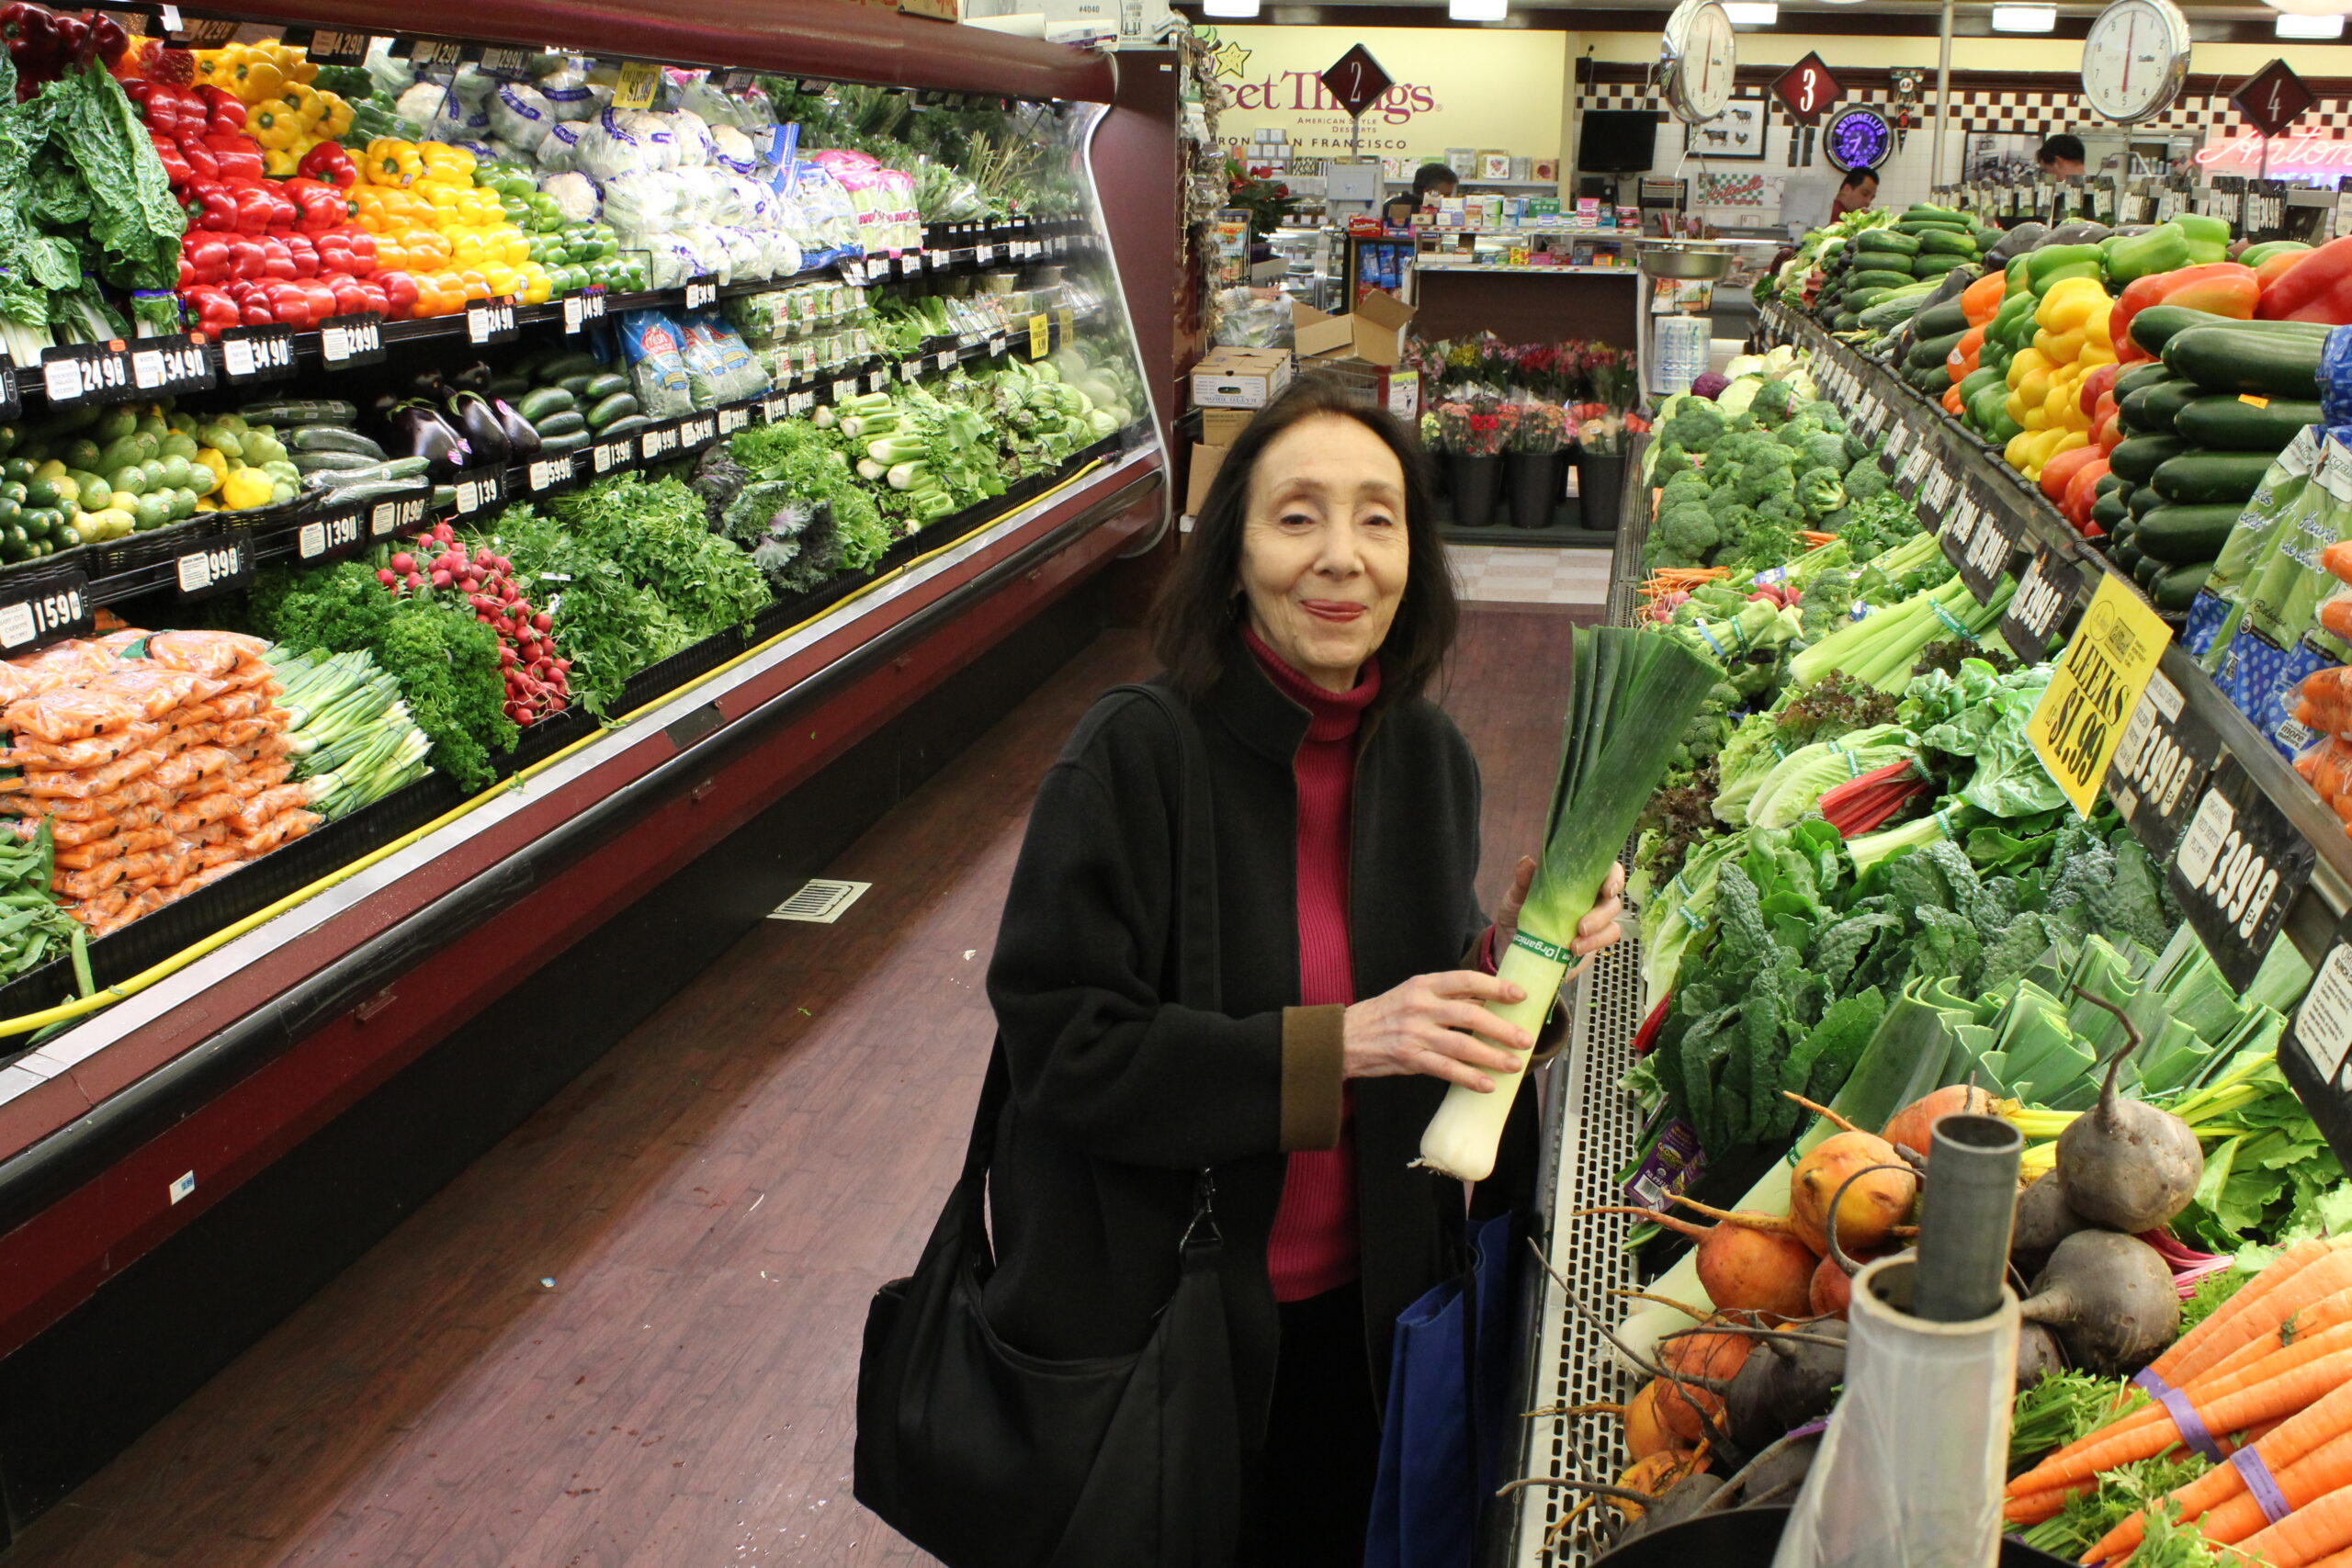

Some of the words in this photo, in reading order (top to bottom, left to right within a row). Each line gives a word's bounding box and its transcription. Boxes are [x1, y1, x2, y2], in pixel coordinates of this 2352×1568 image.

[1350, 62, 1362, 103] 2
[1799, 68, 1816, 113] 3
[2267, 78, 2282, 122] 4
[1297, 117, 1346, 125] AMERICAN
[1312, 139, 1408, 149] FRANCISCO
[252, 340, 281, 368] 349
[348, 325, 372, 354] 289
[80, 357, 116, 391] 249
[164, 349, 196, 381] 349
[477, 479, 497, 506] 139
[325, 516, 350, 548] 139
[209, 549, 230, 581] 99
[34, 594, 72, 633] 159
[2066, 632, 2132, 727] LEEKS
[2047, 686, 2107, 787] $1.99
[2133, 724, 2181, 806] 399
[2206, 830, 2266, 924] 399
